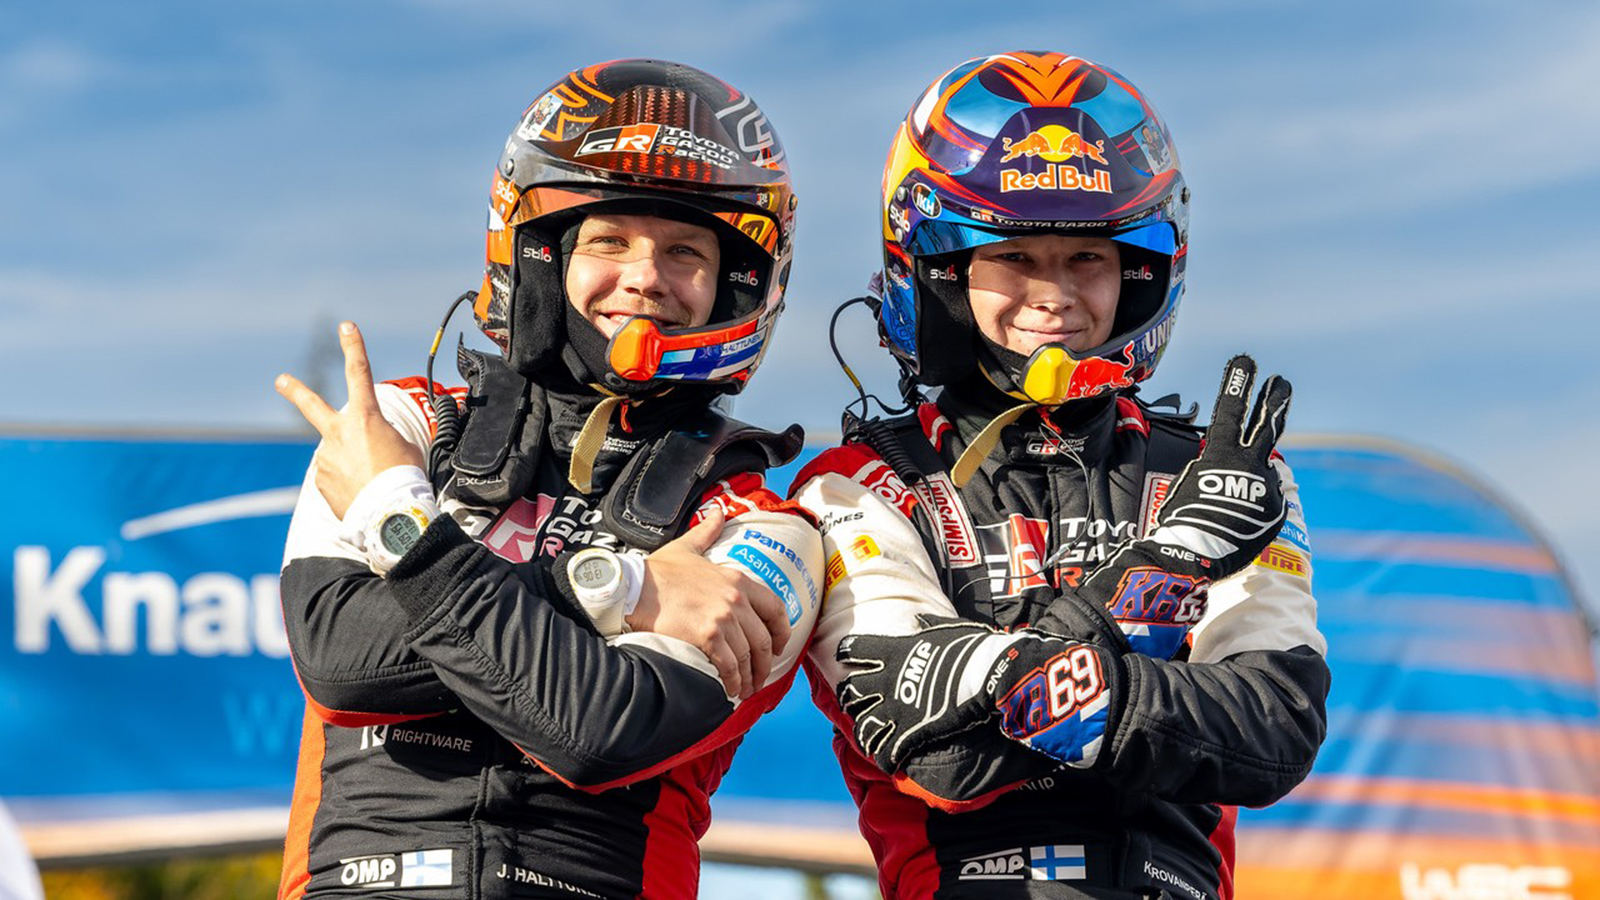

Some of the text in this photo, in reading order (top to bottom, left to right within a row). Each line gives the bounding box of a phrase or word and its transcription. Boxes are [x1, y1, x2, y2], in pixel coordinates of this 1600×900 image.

[579, 133, 653, 154] GR
[660, 136, 732, 164] GAZOO
[665, 126, 740, 160] TOYOTA
[657, 144, 731, 169] Racing
[1000, 164, 1113, 193] Red Bull
[997, 218, 1051, 227] TOYOTA
[1054, 220, 1107, 228] GAZOO
[523, 246, 552, 262] Stilo
[728, 269, 759, 287] Stilo
[929, 265, 958, 281] Stilo
[1123, 265, 1153, 281] Stilo
[1227, 366, 1248, 397] OMP
[456, 475, 503, 487] EXCEL
[1197, 474, 1267, 503] OMP
[621, 508, 665, 537] EXCEL
[744, 529, 818, 609] Panasonic
[899, 641, 933, 705] OMP
[392, 729, 473, 752] RIGHTWARE
[341, 858, 396, 885] OMP
[497, 863, 511, 879] J.
[960, 854, 1025, 875] OMP
